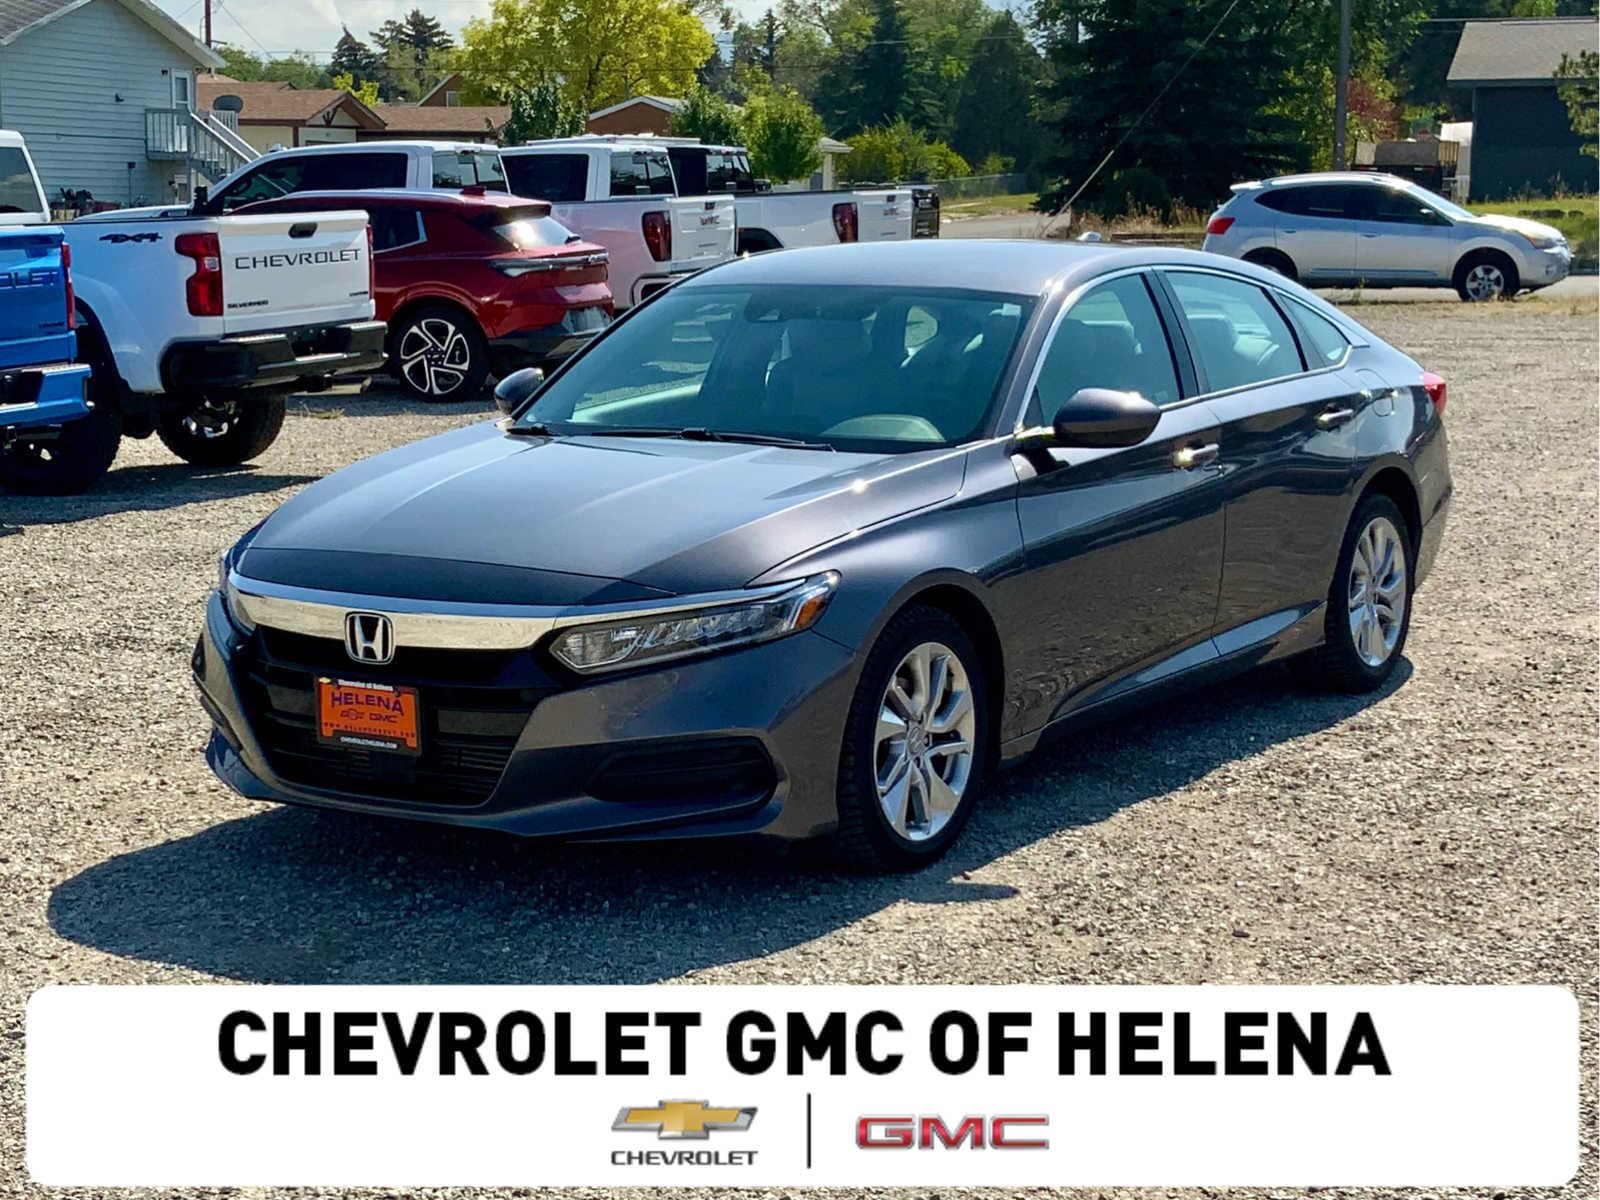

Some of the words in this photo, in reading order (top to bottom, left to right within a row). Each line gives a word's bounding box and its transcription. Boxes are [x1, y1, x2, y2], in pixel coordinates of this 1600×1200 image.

[234, 249, 361, 270] CHEVROLET
[331, 691, 404, 716] HELENA
[369, 712, 398, 723] GMC
